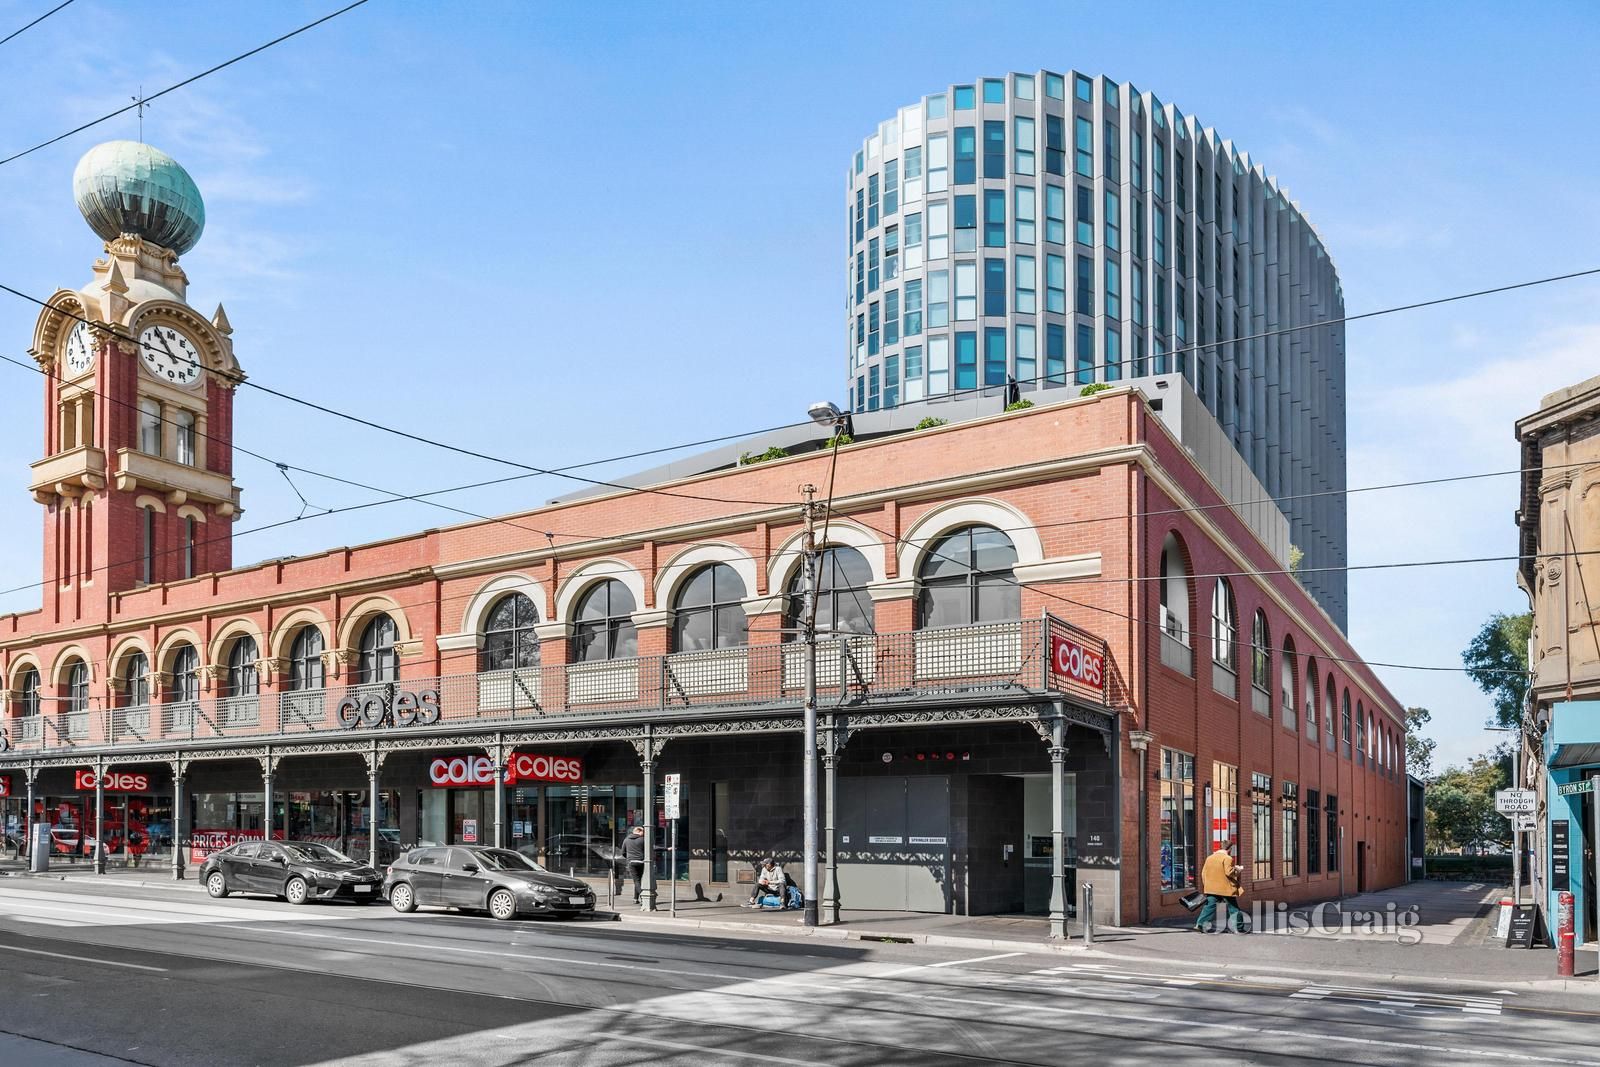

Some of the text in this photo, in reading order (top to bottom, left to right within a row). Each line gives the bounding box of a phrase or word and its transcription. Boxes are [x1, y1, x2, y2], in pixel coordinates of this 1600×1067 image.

[147, 353, 194, 380] STORE
[1059, 643, 1101, 685] coles
[516, 755, 581, 780] coles
[1558, 782, 1586, 795] BYRON ST
[193, 834, 229, 848] PRICES
